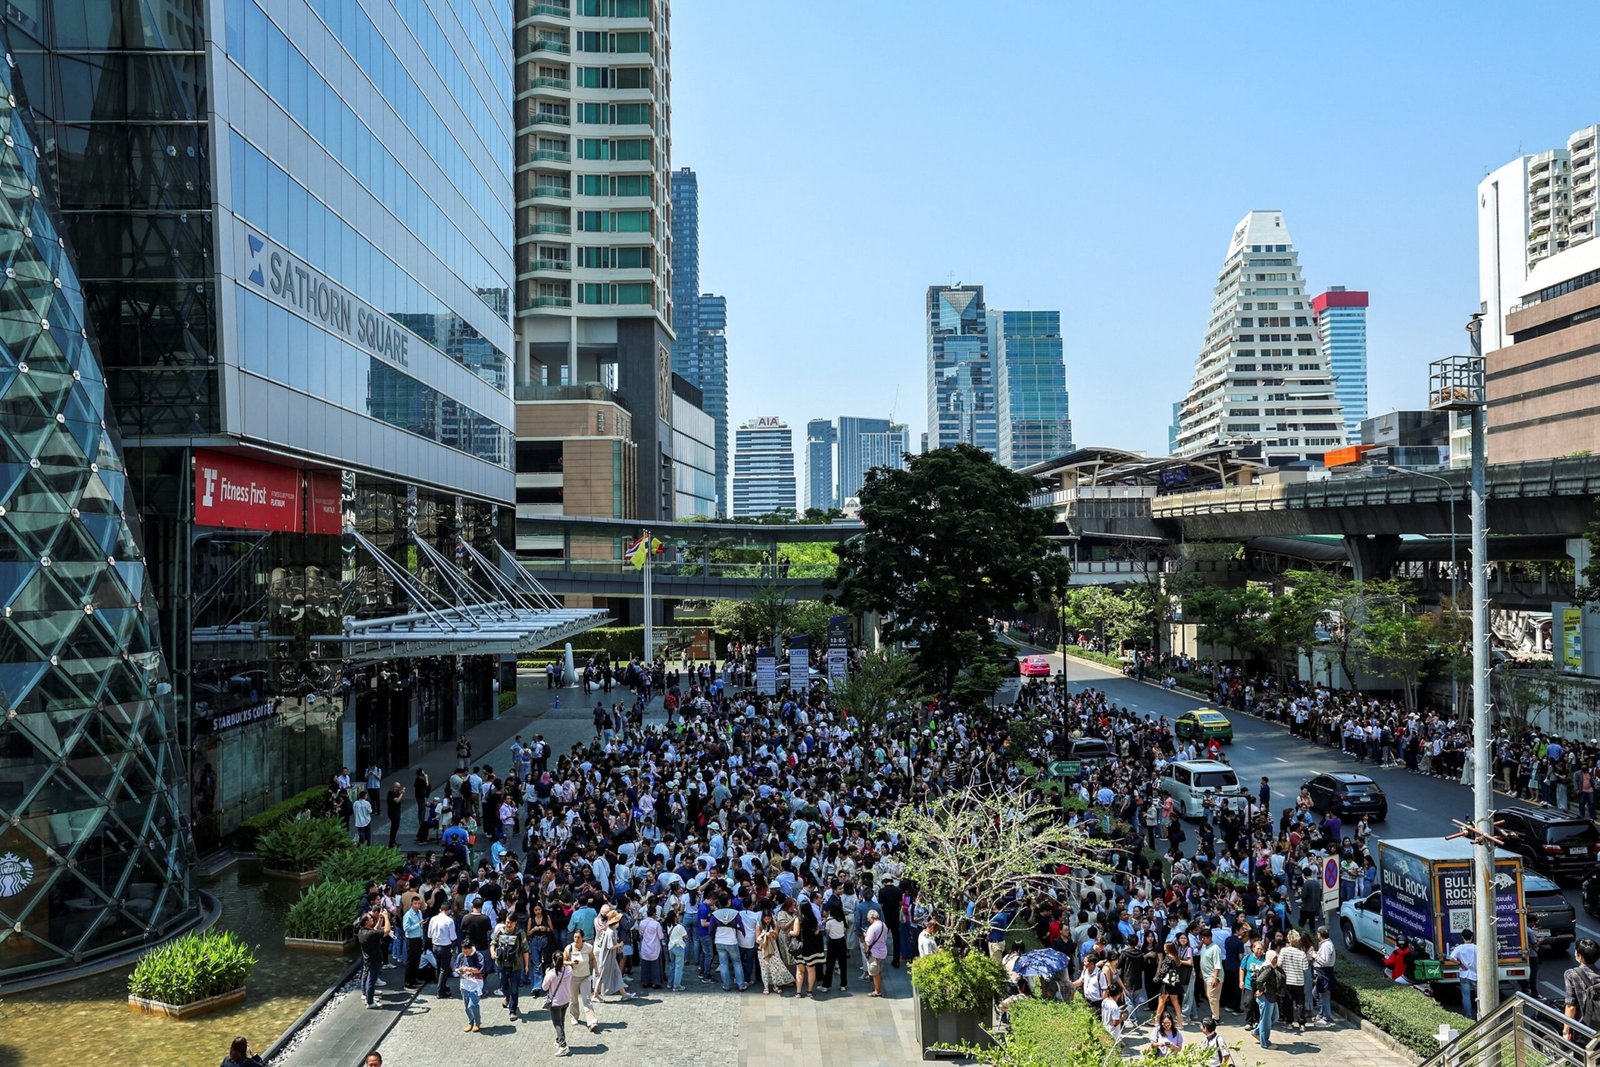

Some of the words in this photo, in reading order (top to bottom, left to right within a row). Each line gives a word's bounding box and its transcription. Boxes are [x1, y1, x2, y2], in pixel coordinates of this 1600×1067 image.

[269, 251, 351, 336] SATHORN
[357, 307, 409, 368] SQUARE
[758, 417, 778, 426] AIA
[220, 477, 249, 503] Fitness
[250, 482, 267, 506] First
[212, 708, 252, 731] STARBUCKS
[1383, 869, 1404, 891] BULL
[1405, 878, 1429, 902] ROCK
[1444, 876, 1475, 889] BULL
[1396, 892, 1415, 906] LOGISTICS
[1445, 887, 1476, 900] ROCK
